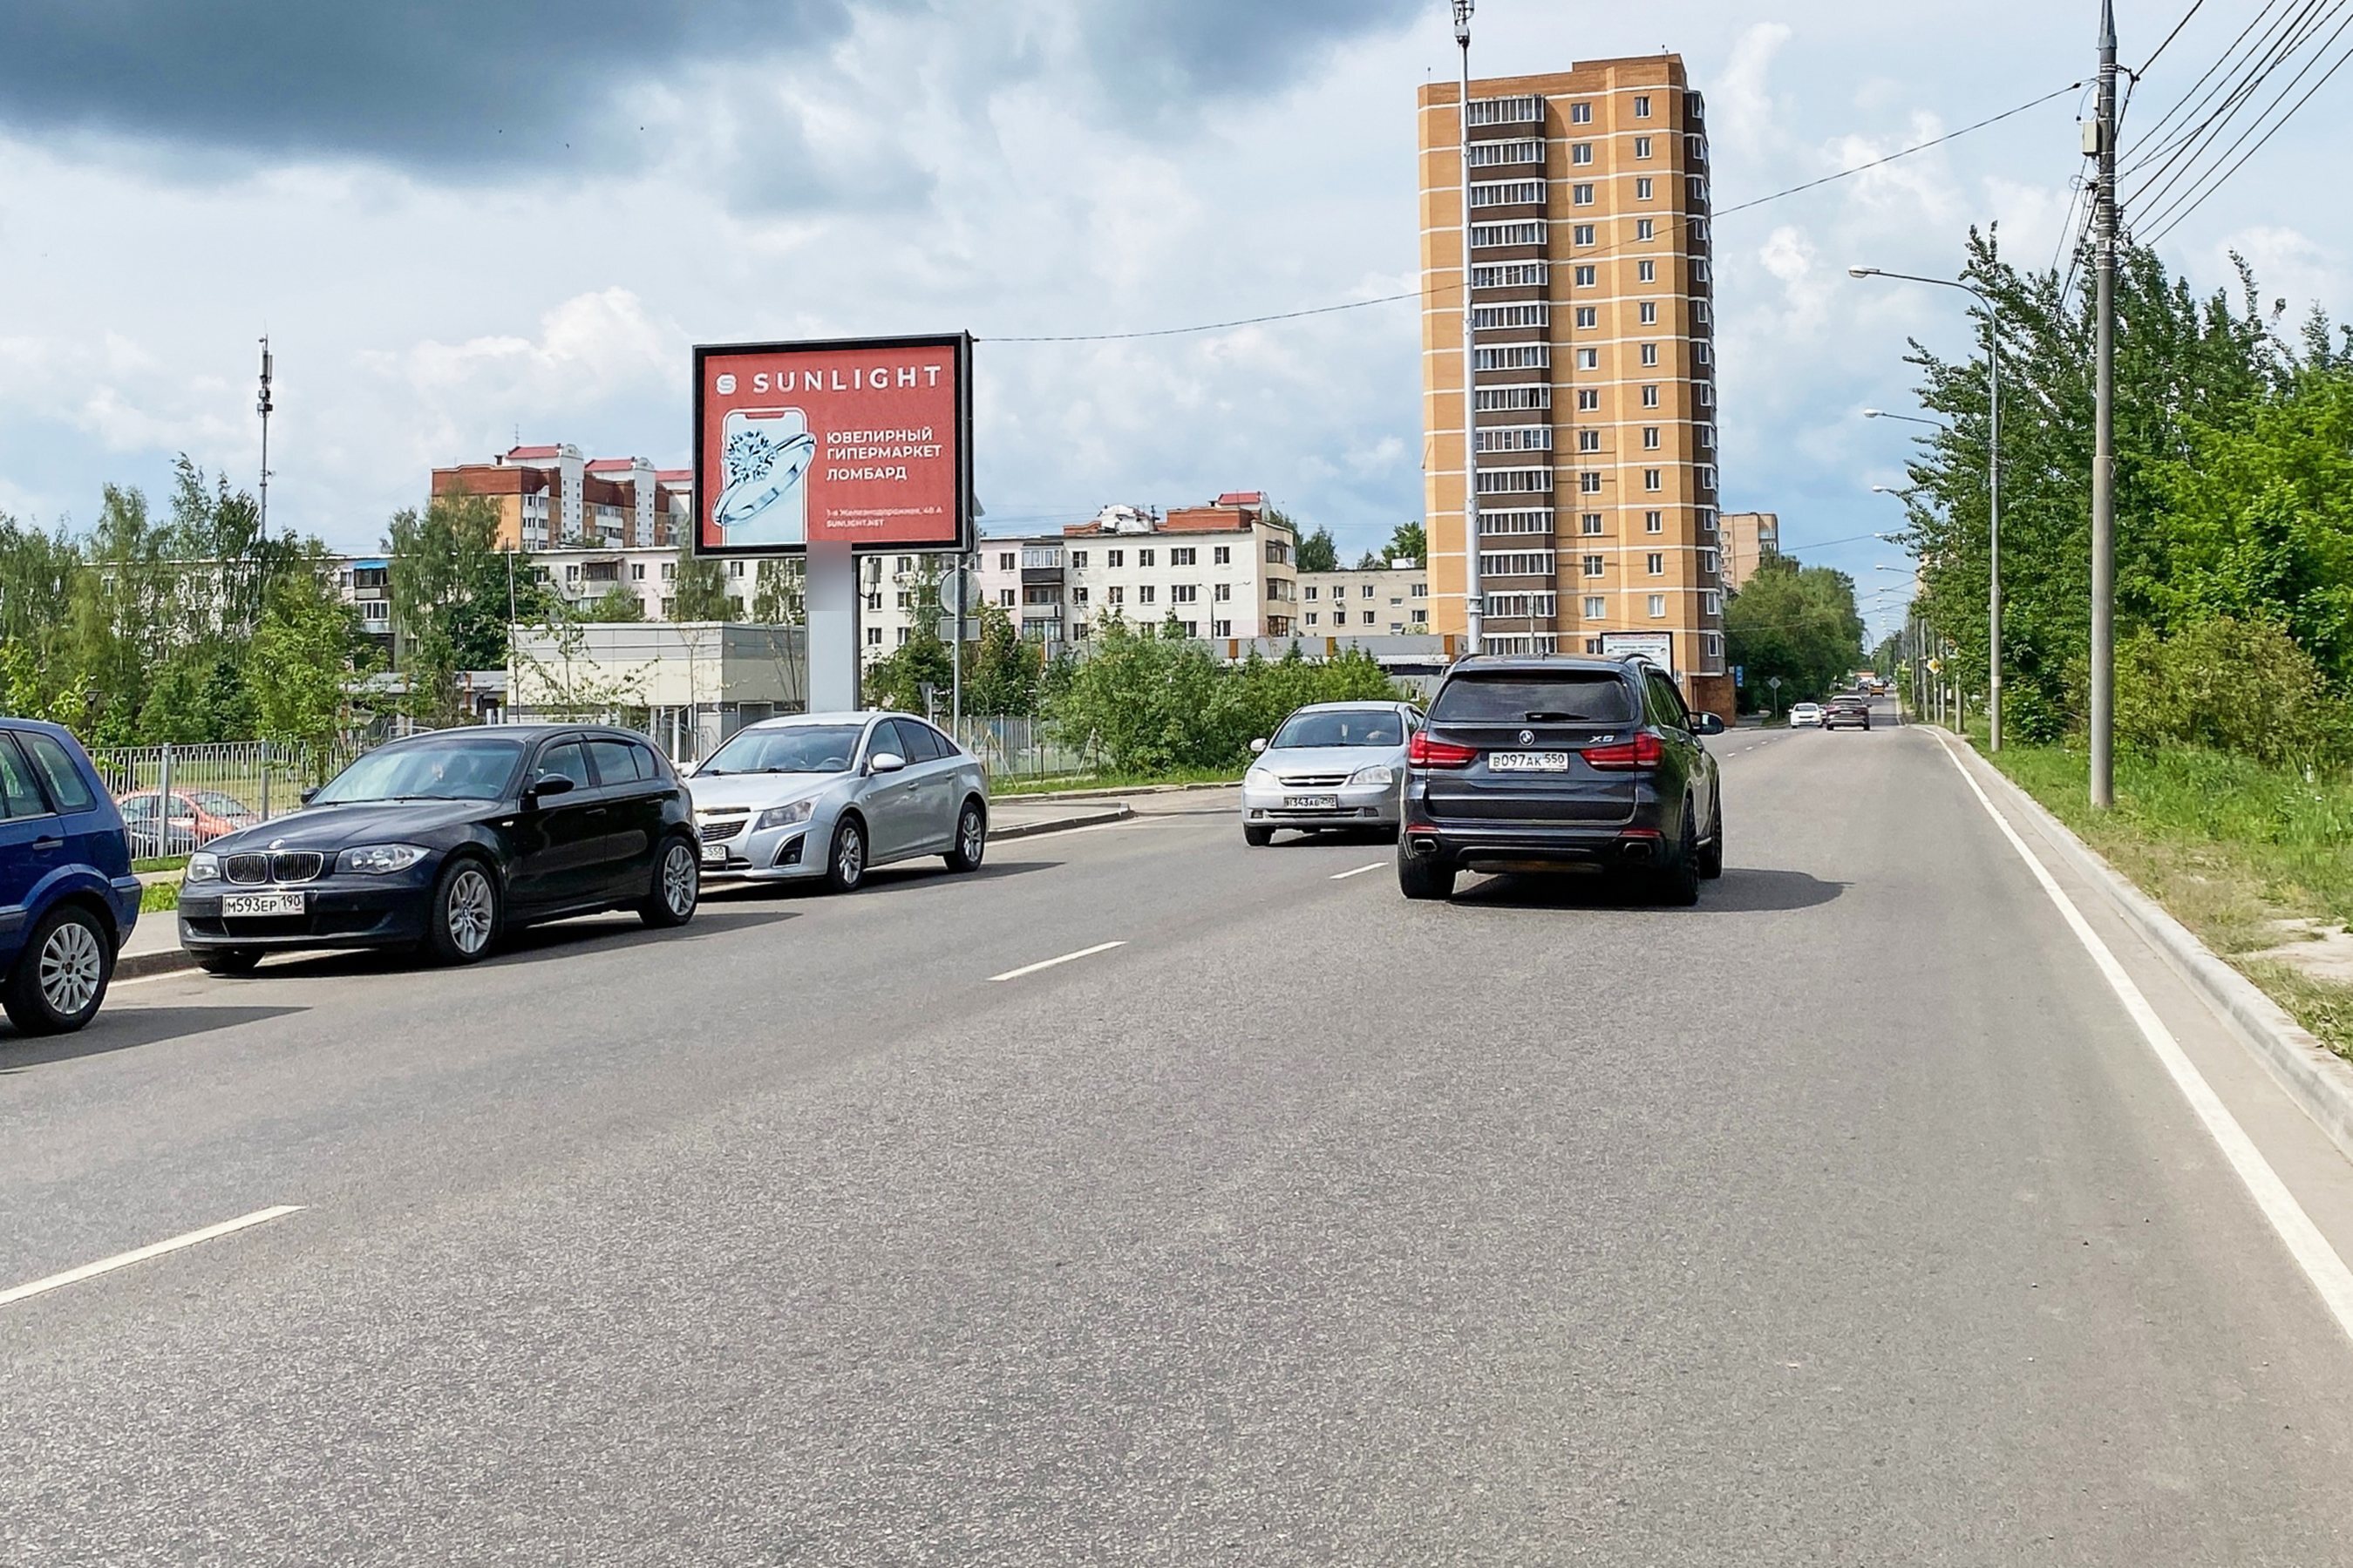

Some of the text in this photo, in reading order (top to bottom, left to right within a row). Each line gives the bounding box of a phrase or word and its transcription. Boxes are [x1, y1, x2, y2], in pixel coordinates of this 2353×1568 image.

[752, 365, 941, 393] SUNLIGHT
[826, 426, 933, 444] ЮВЕЛИРНЫЙ
[826, 445, 942, 460] ГИПЕРМАРКЕТ
[826, 465, 908, 481] ЛОМБАРД
